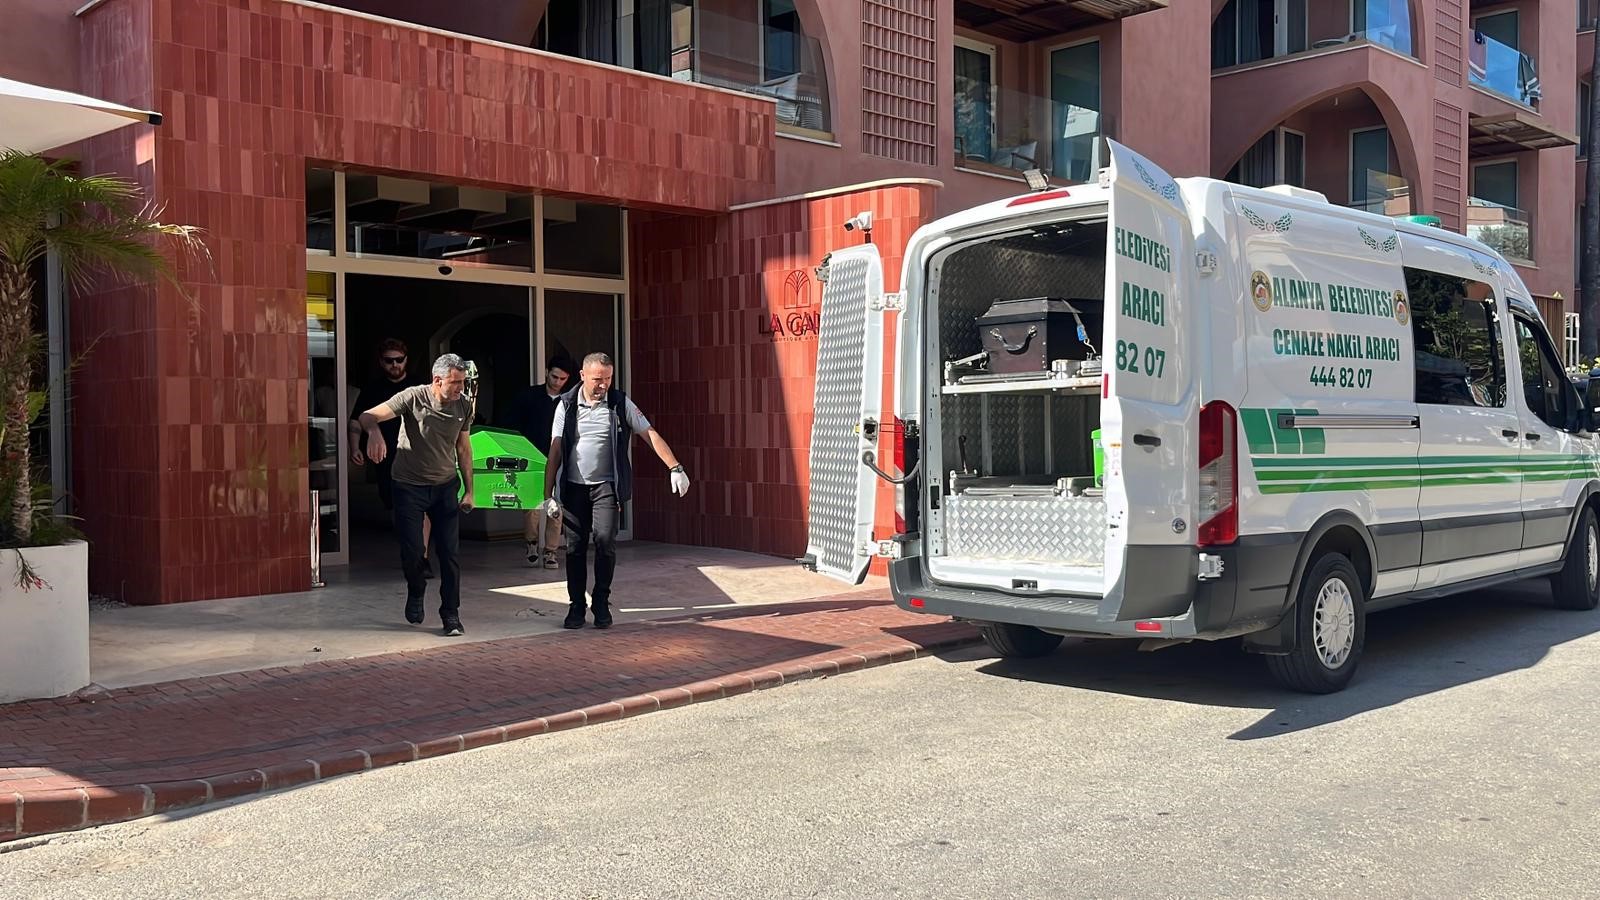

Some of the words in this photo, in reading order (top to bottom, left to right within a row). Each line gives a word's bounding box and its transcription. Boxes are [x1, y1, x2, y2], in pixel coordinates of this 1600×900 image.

[1122, 281, 1165, 327] ARACI
[1272, 277, 1325, 311] ALANYA
[759, 313, 783, 335] LA
[1116, 339, 1139, 373] 82
[1144, 346, 1165, 378] 07
[1272, 328, 1325, 357] CENAZE
[1365, 336, 1400, 361] ARACI
[1310, 366, 1336, 387] 444
[1339, 367, 1354, 388] 82
[1358, 368, 1373, 388] 07
